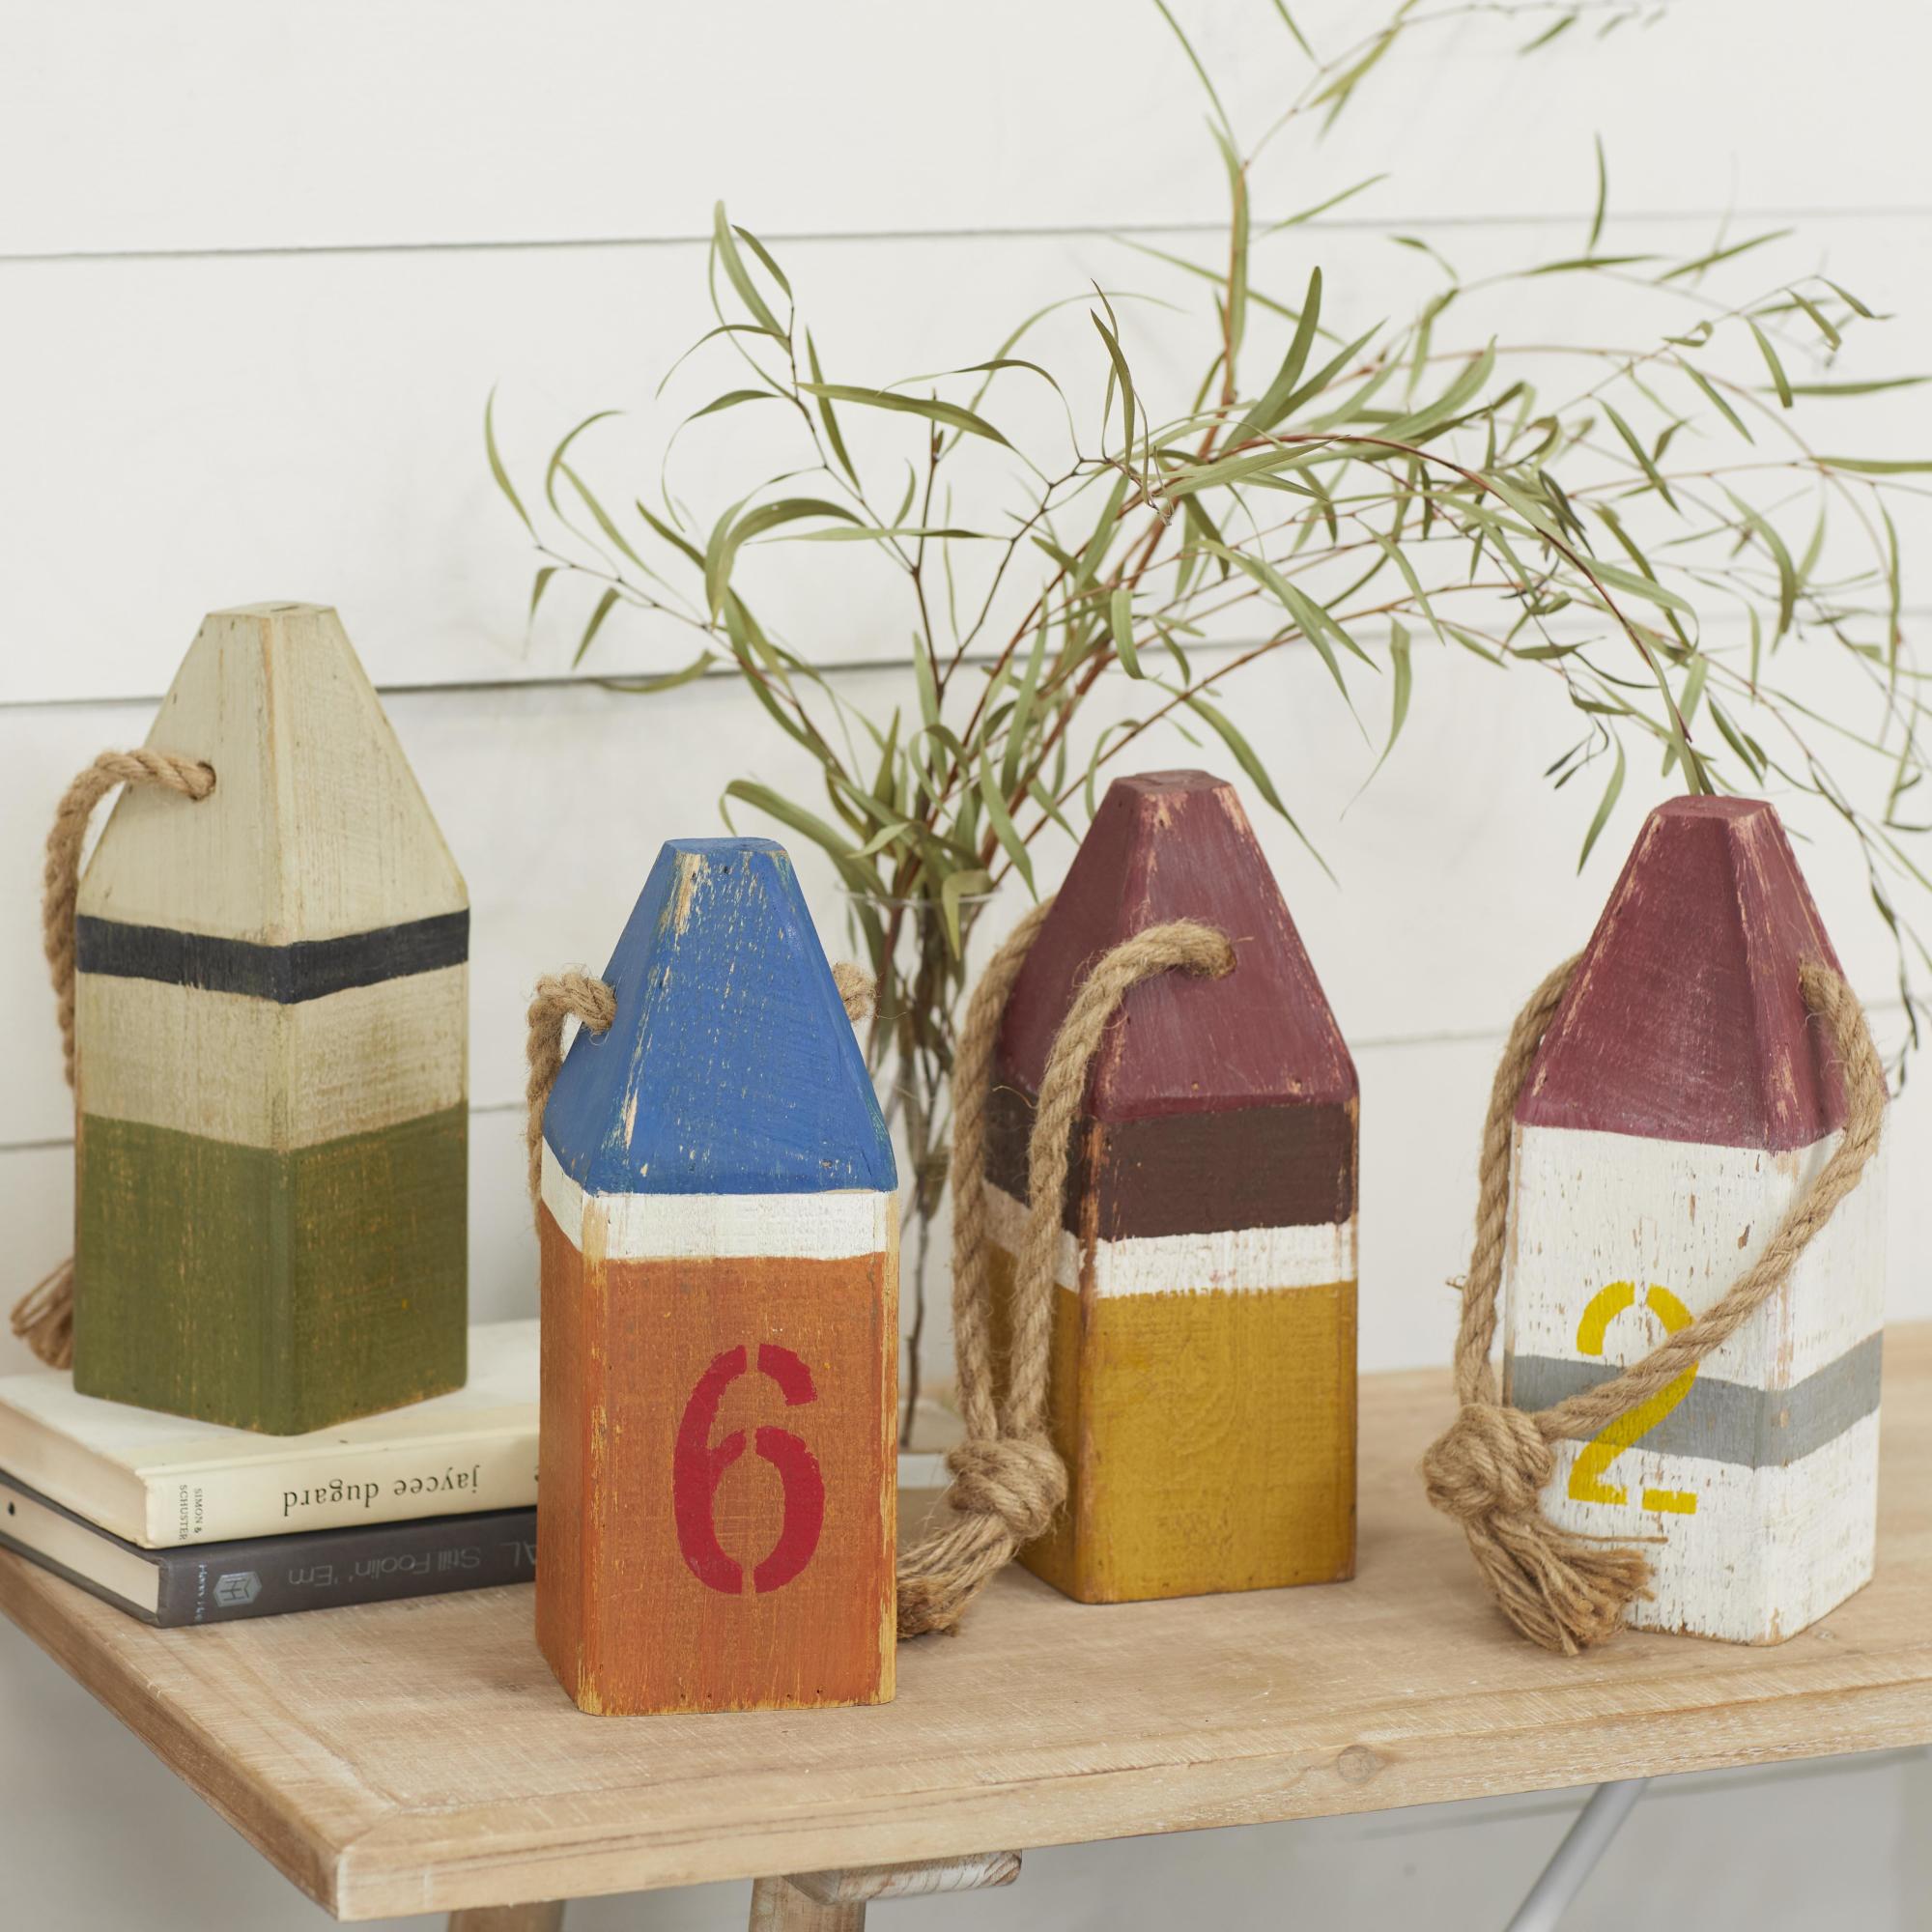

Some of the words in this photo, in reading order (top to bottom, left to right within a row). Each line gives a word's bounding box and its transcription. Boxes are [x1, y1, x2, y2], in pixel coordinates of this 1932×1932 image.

[1568, 1280, 1698, 1515] 2
[393, 1464, 481, 1494] jaycee
[671, 1343, 825, 1595] 6
[179, 1484, 188, 1541] SCHUSTER
[194, 1488, 203, 1523] SIMON
[283, 1478, 379, 1517] dugard
[438, 1547, 481, 1572] Still
